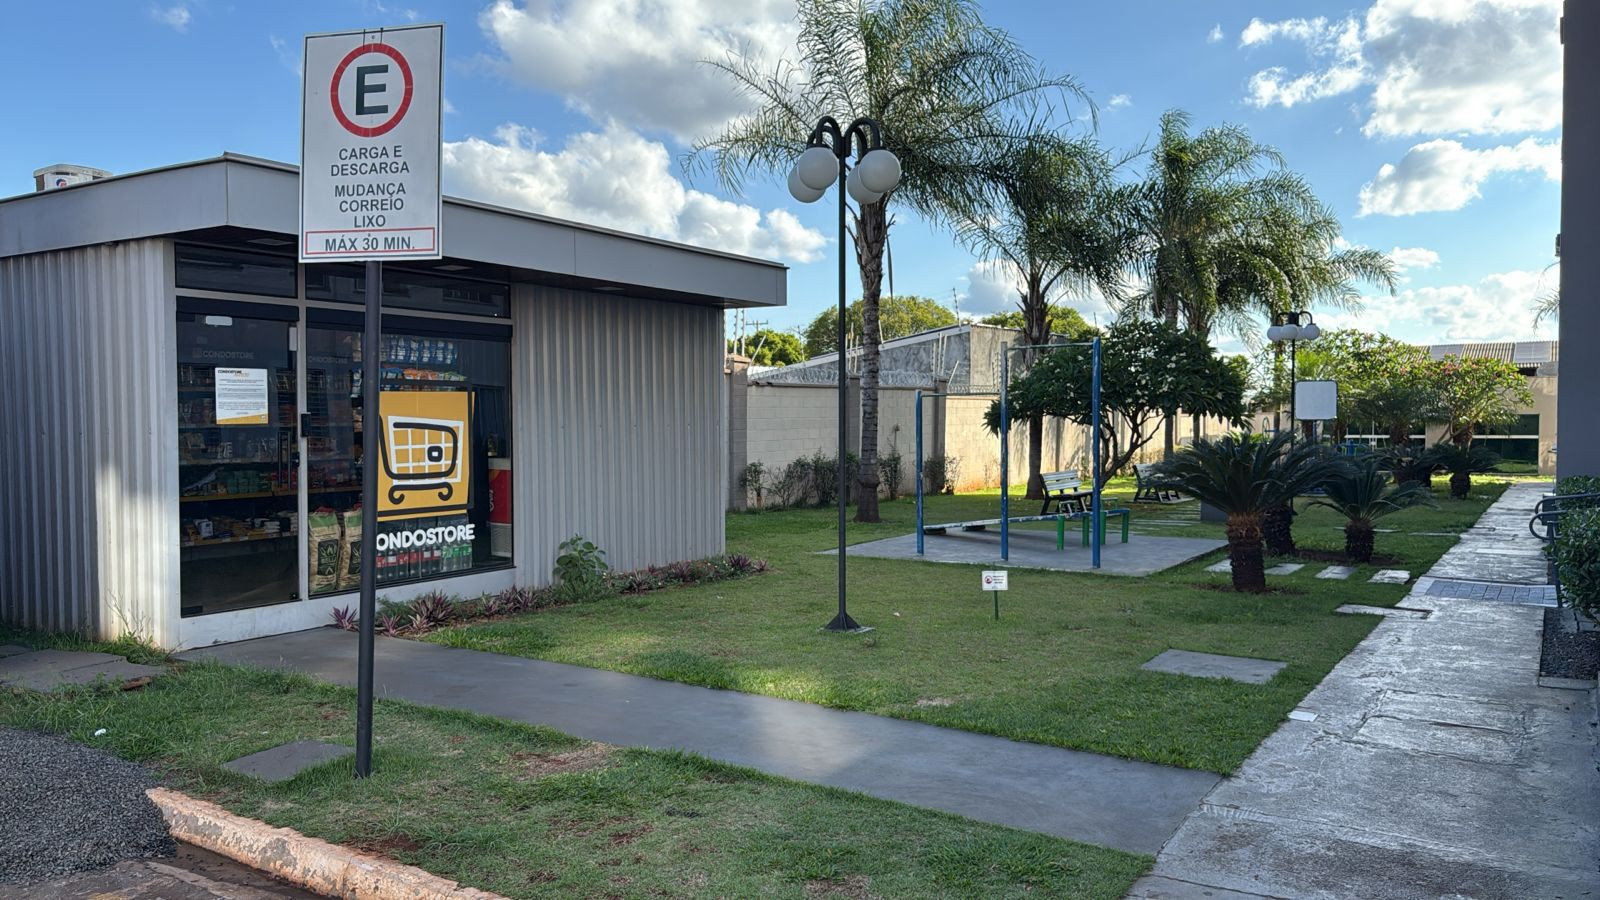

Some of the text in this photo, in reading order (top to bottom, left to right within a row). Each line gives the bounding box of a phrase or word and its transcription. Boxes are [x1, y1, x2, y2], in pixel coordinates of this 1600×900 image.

[356, 65, 388, 115] E
[339, 146, 402, 160] CARGA E
[331, 162, 409, 176] DESCARGA
[335, 183, 405, 198] MUDANÇA
[340, 199, 404, 212] CORREIO
[353, 214, 386, 228] LIXO
[325, 234, 415, 252] MÁX 30 MIN.
[377, 524, 475, 550] ONDOSTORE
